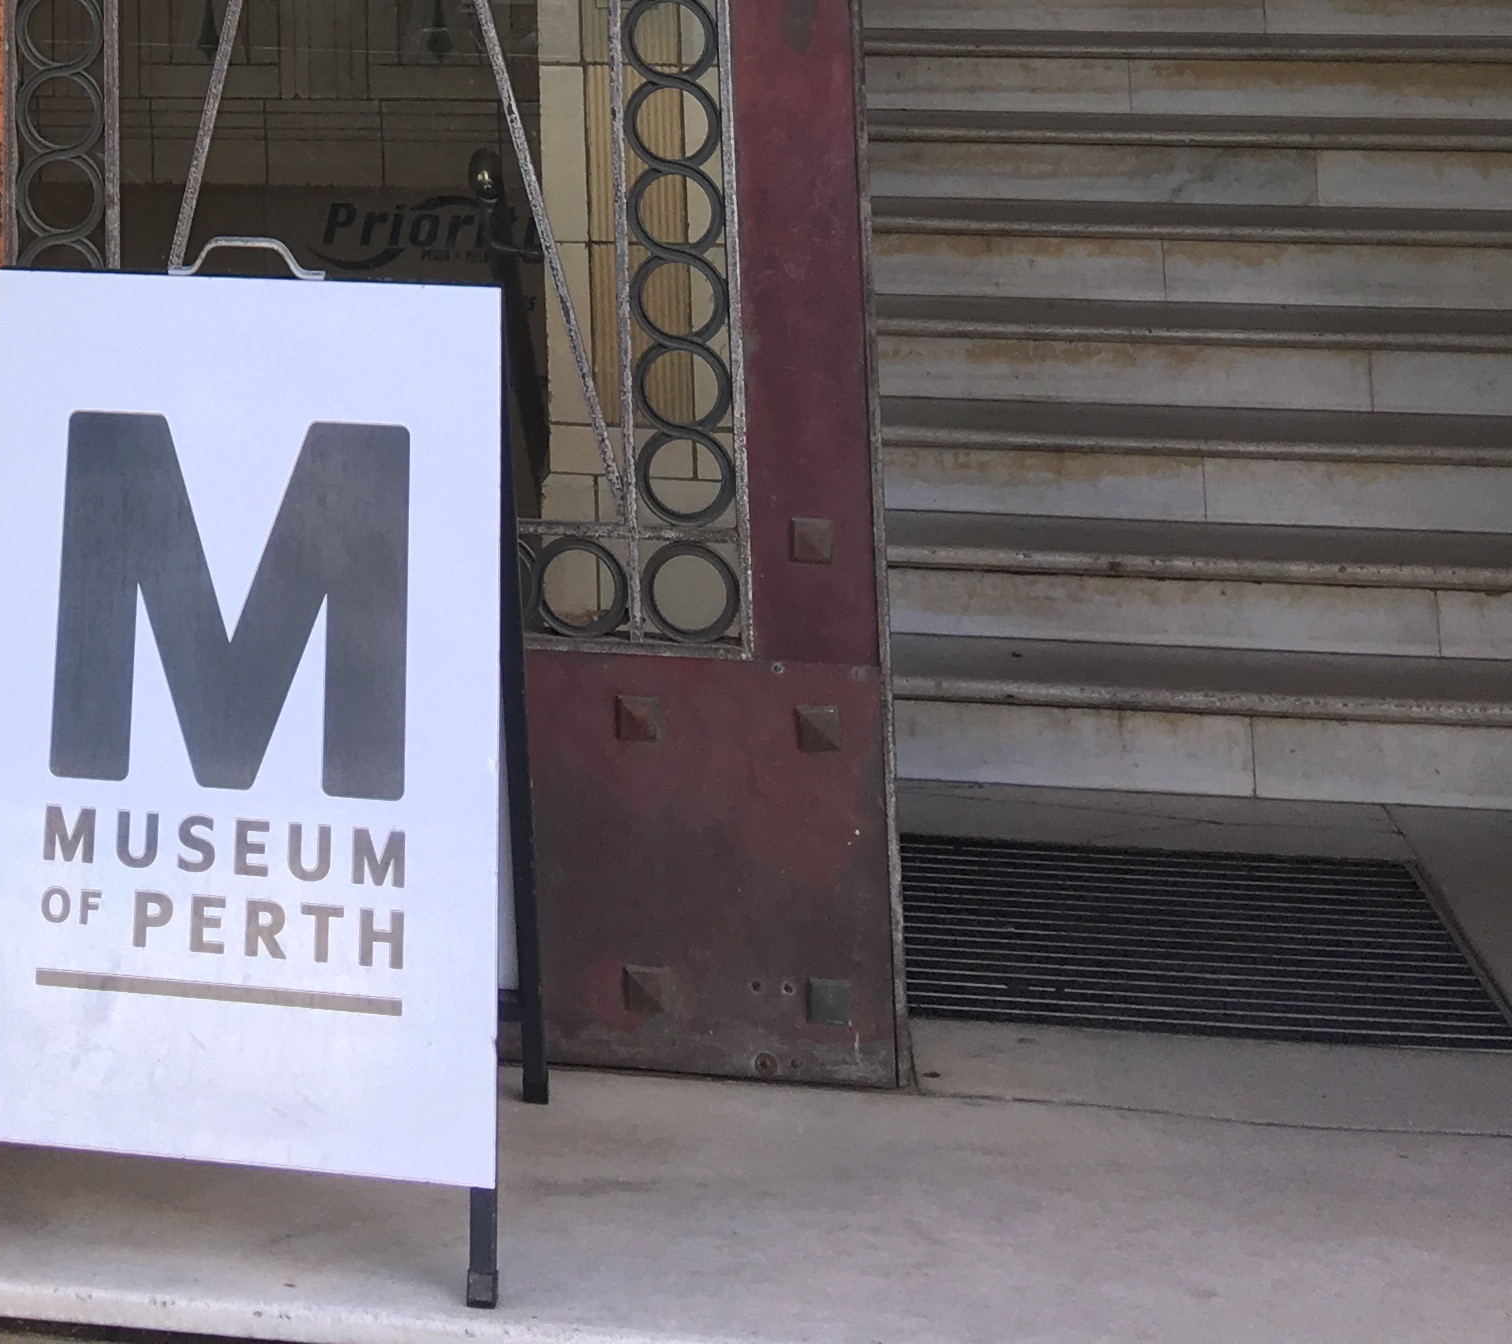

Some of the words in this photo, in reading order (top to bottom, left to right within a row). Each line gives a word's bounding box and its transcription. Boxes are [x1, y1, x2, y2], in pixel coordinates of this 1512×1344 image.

[49, 409, 411, 801] M
[42, 802, 408, 889] MUSEUM
[40, 884, 103, 926] OF
[132, 888, 405, 971] PERTH
